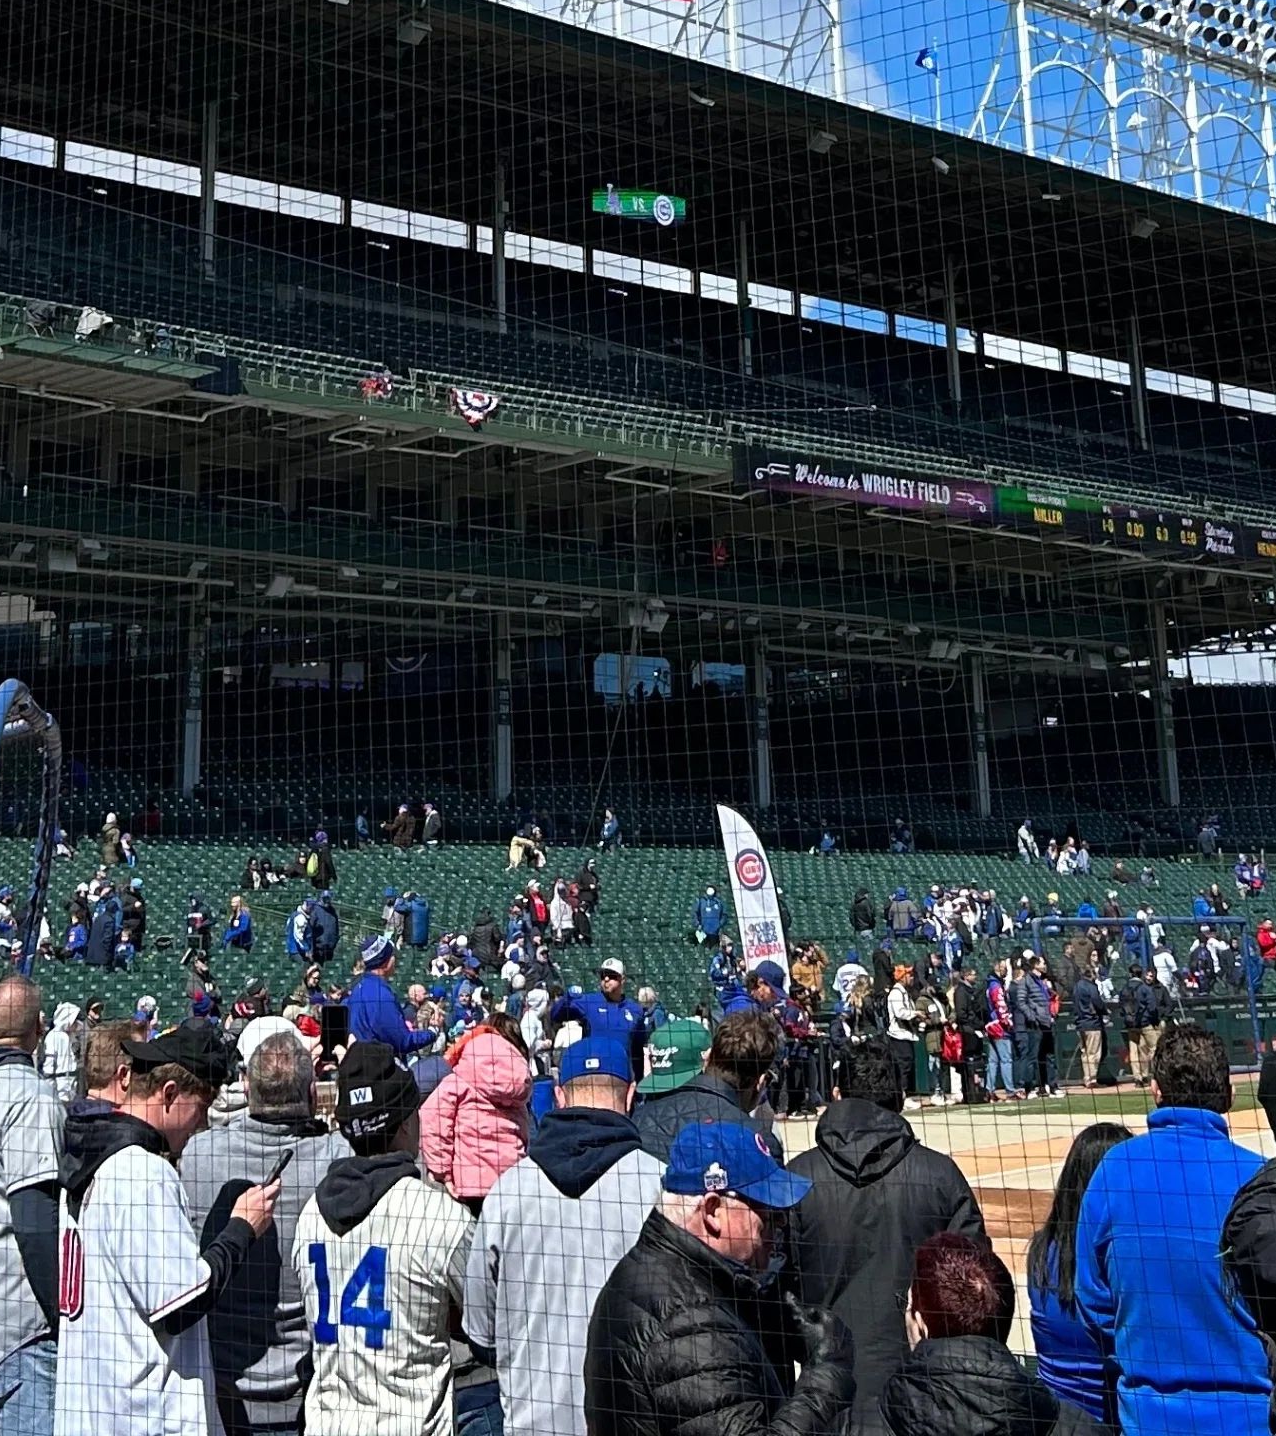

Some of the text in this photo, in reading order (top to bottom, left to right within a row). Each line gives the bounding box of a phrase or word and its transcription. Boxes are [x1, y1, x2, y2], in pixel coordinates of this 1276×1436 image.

[795, 463, 951, 506] Welcome to WRIGLEY FIELD
[1033, 506, 1064, 526] MILLER
[754, 920, 776, 934] CUBS
[756, 931, 778, 944] KIDS
[746, 943, 785, 960] CORRAL
[353, 1087, 367, 1103] W
[308, 1242, 392, 1351] 14
